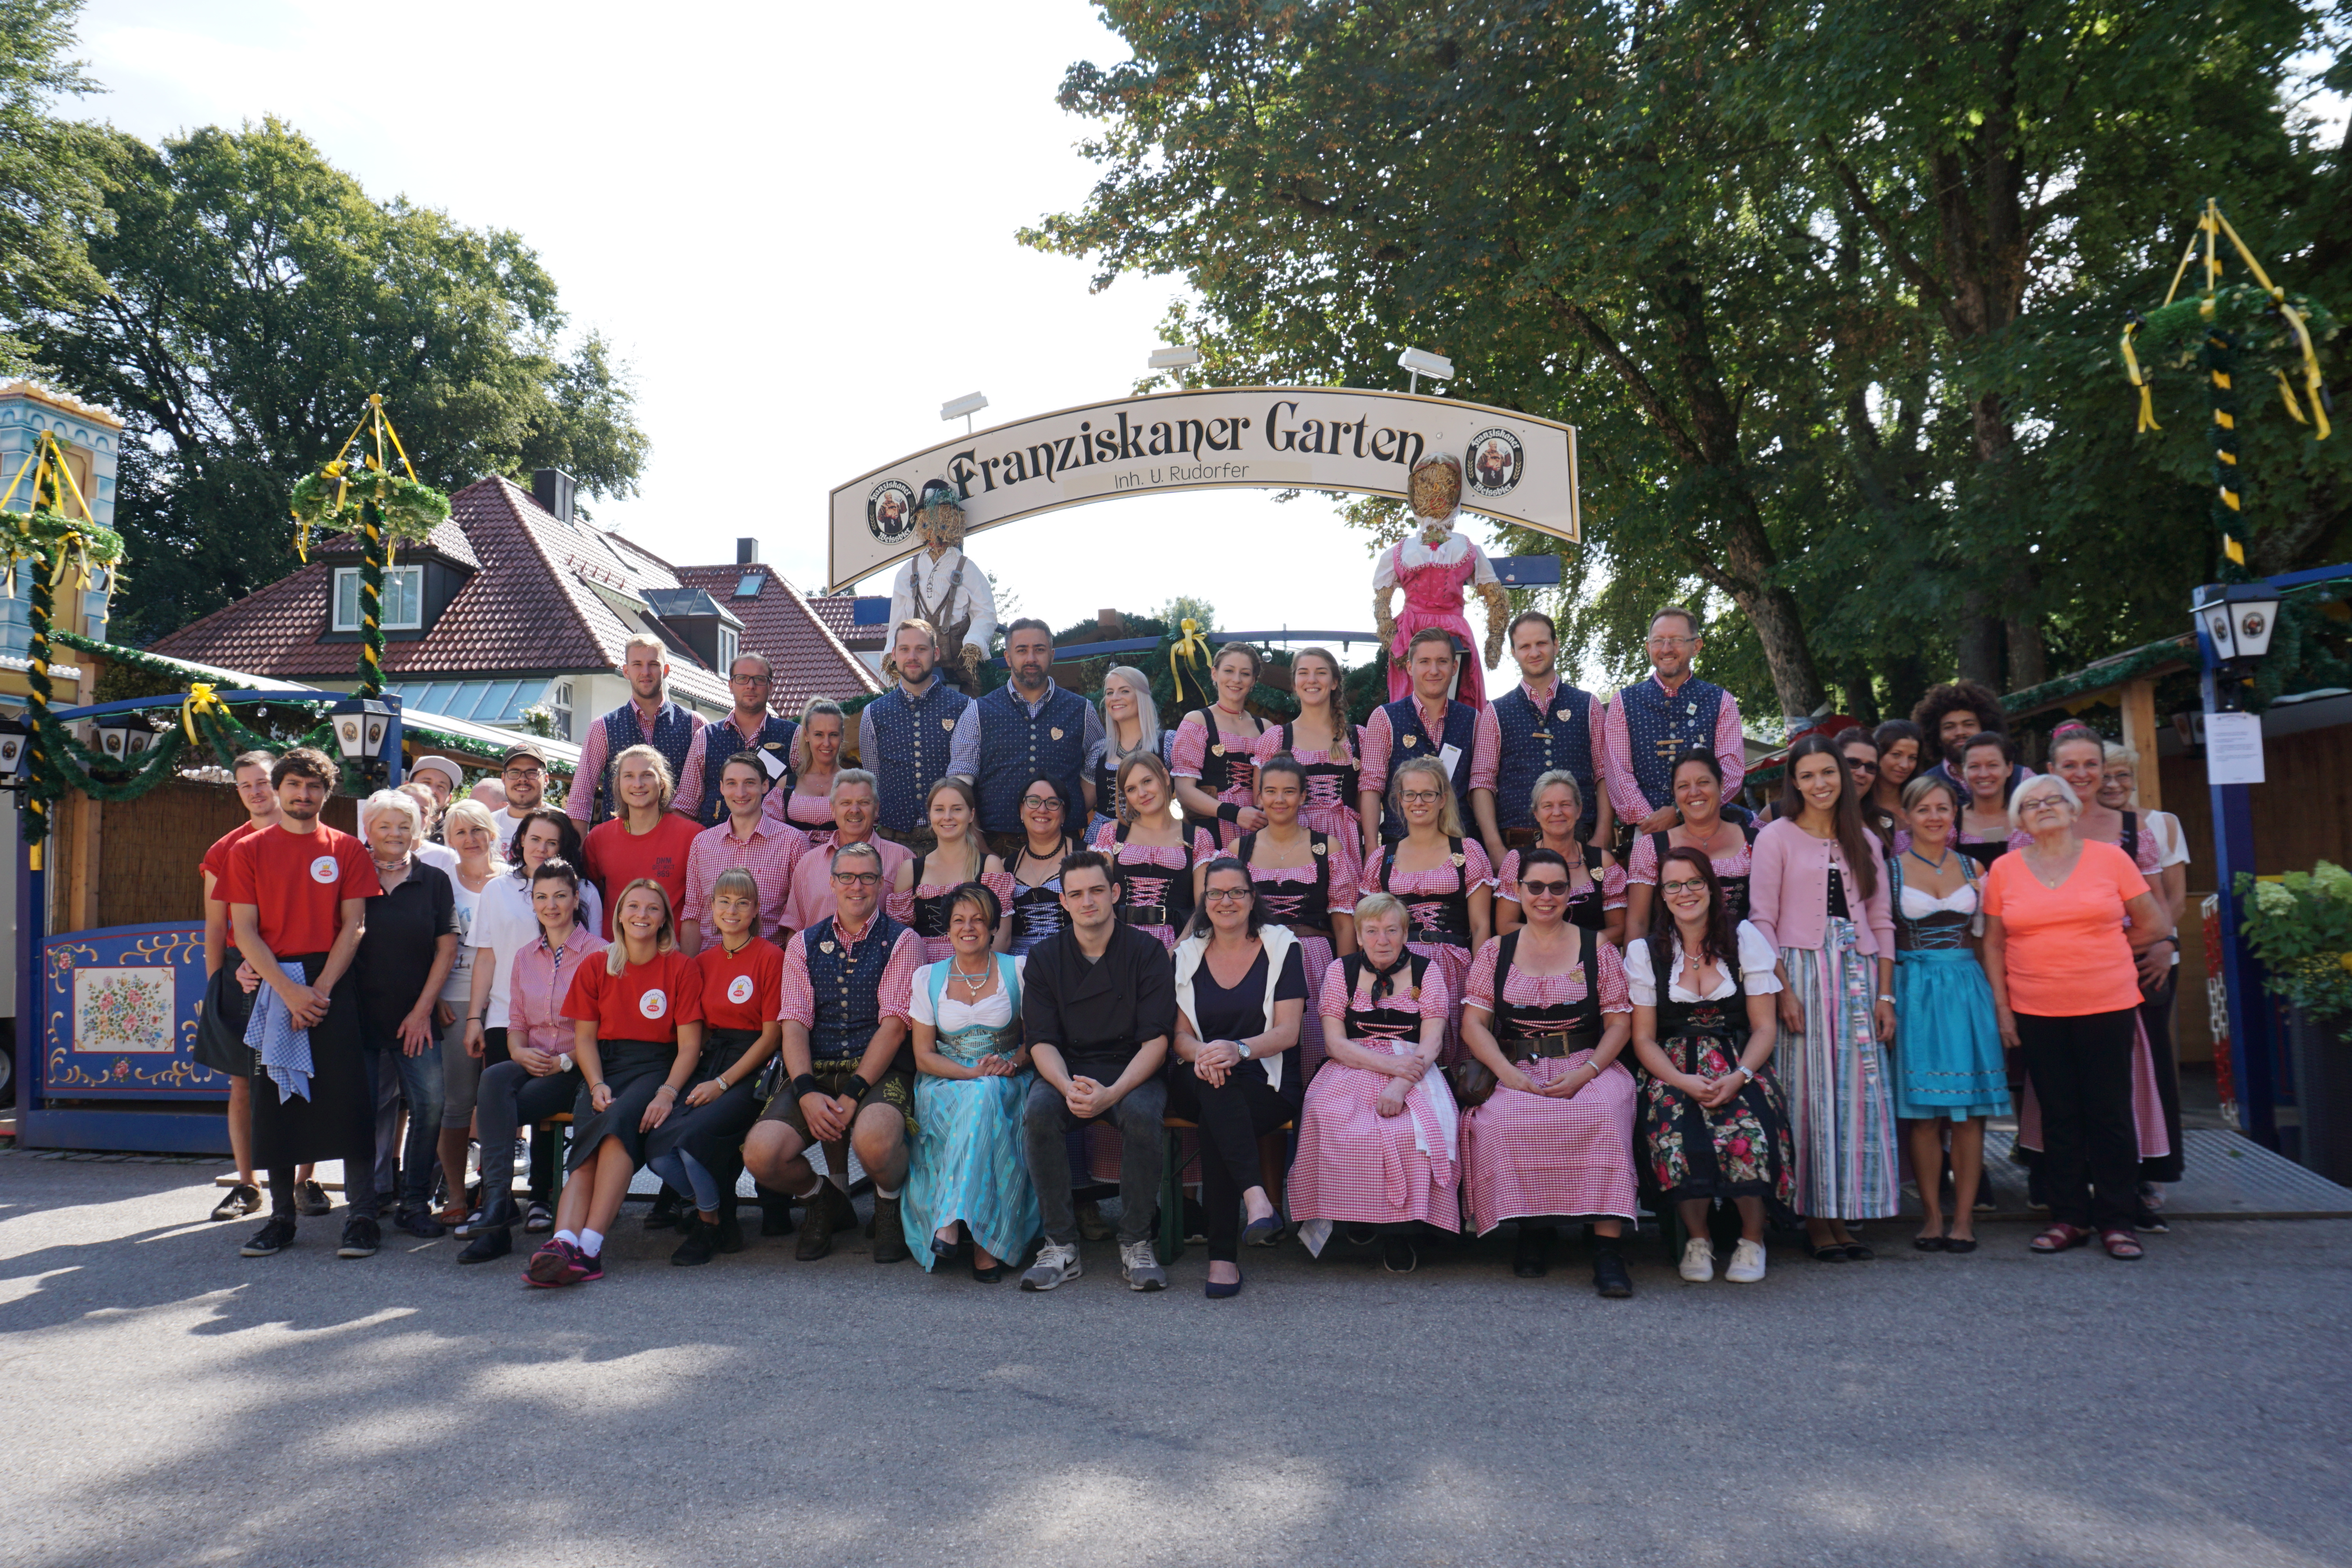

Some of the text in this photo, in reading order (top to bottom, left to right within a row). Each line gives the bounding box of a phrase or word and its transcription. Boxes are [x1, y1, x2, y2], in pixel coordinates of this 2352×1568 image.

[1471, 429, 1520, 449] Franziskaner
[947, 400, 1424, 501] Franziskaner Garten
[1114, 463, 1250, 490] Inh. U. Rudorfer
[869, 481, 911, 502] Franziskaner
[1473, 481, 1513, 497] Weissbier
[878, 527, 911, 543] Weissbier
